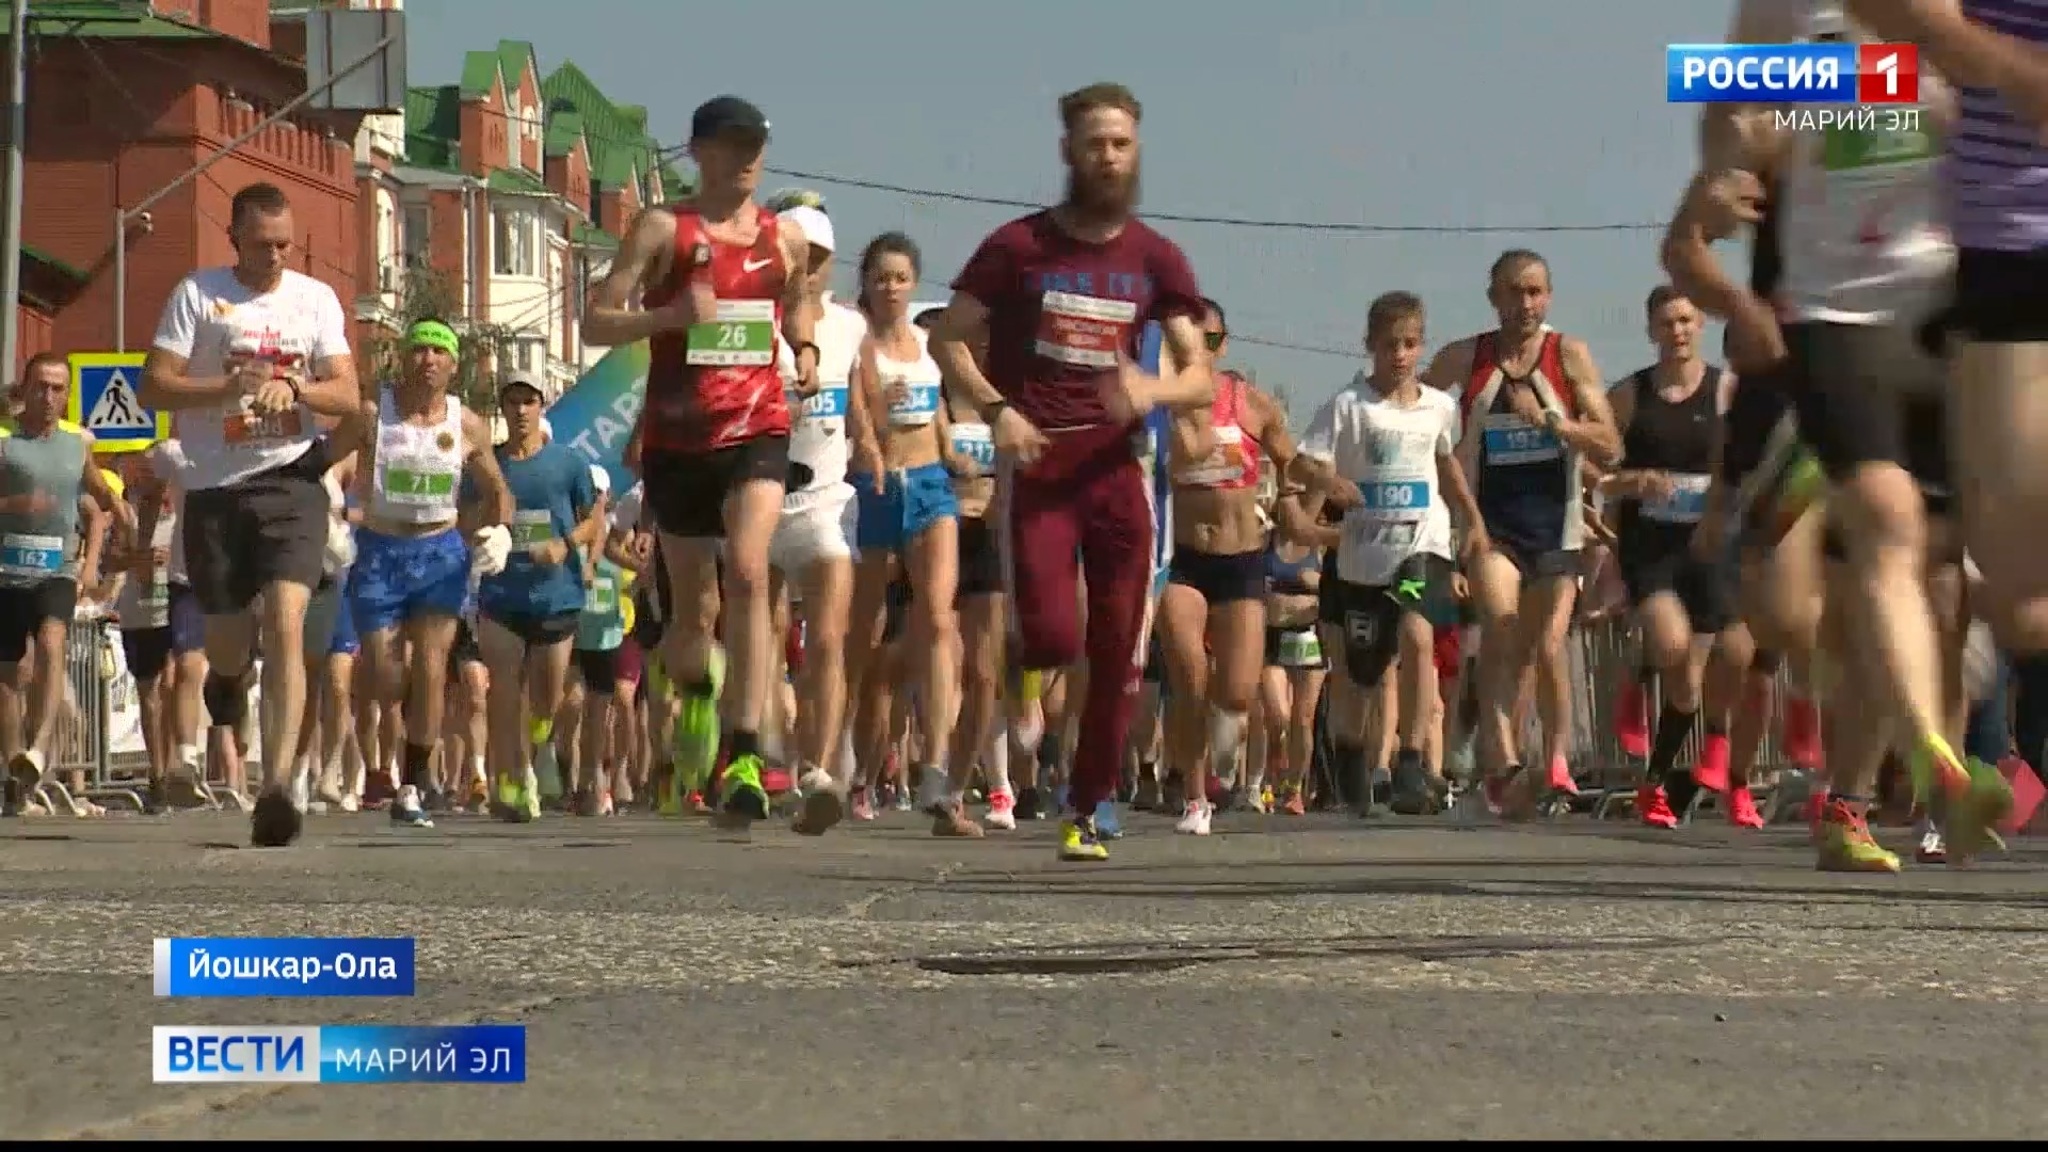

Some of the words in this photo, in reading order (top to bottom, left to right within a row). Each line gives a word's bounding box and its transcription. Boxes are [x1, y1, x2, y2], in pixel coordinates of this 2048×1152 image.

[717, 323, 747, 349] 26
[808, 391, 835, 414] 05
[411, 475, 430, 493] 71
[1376, 485, 1413, 506] 190
[17, 550, 48, 568] 162
